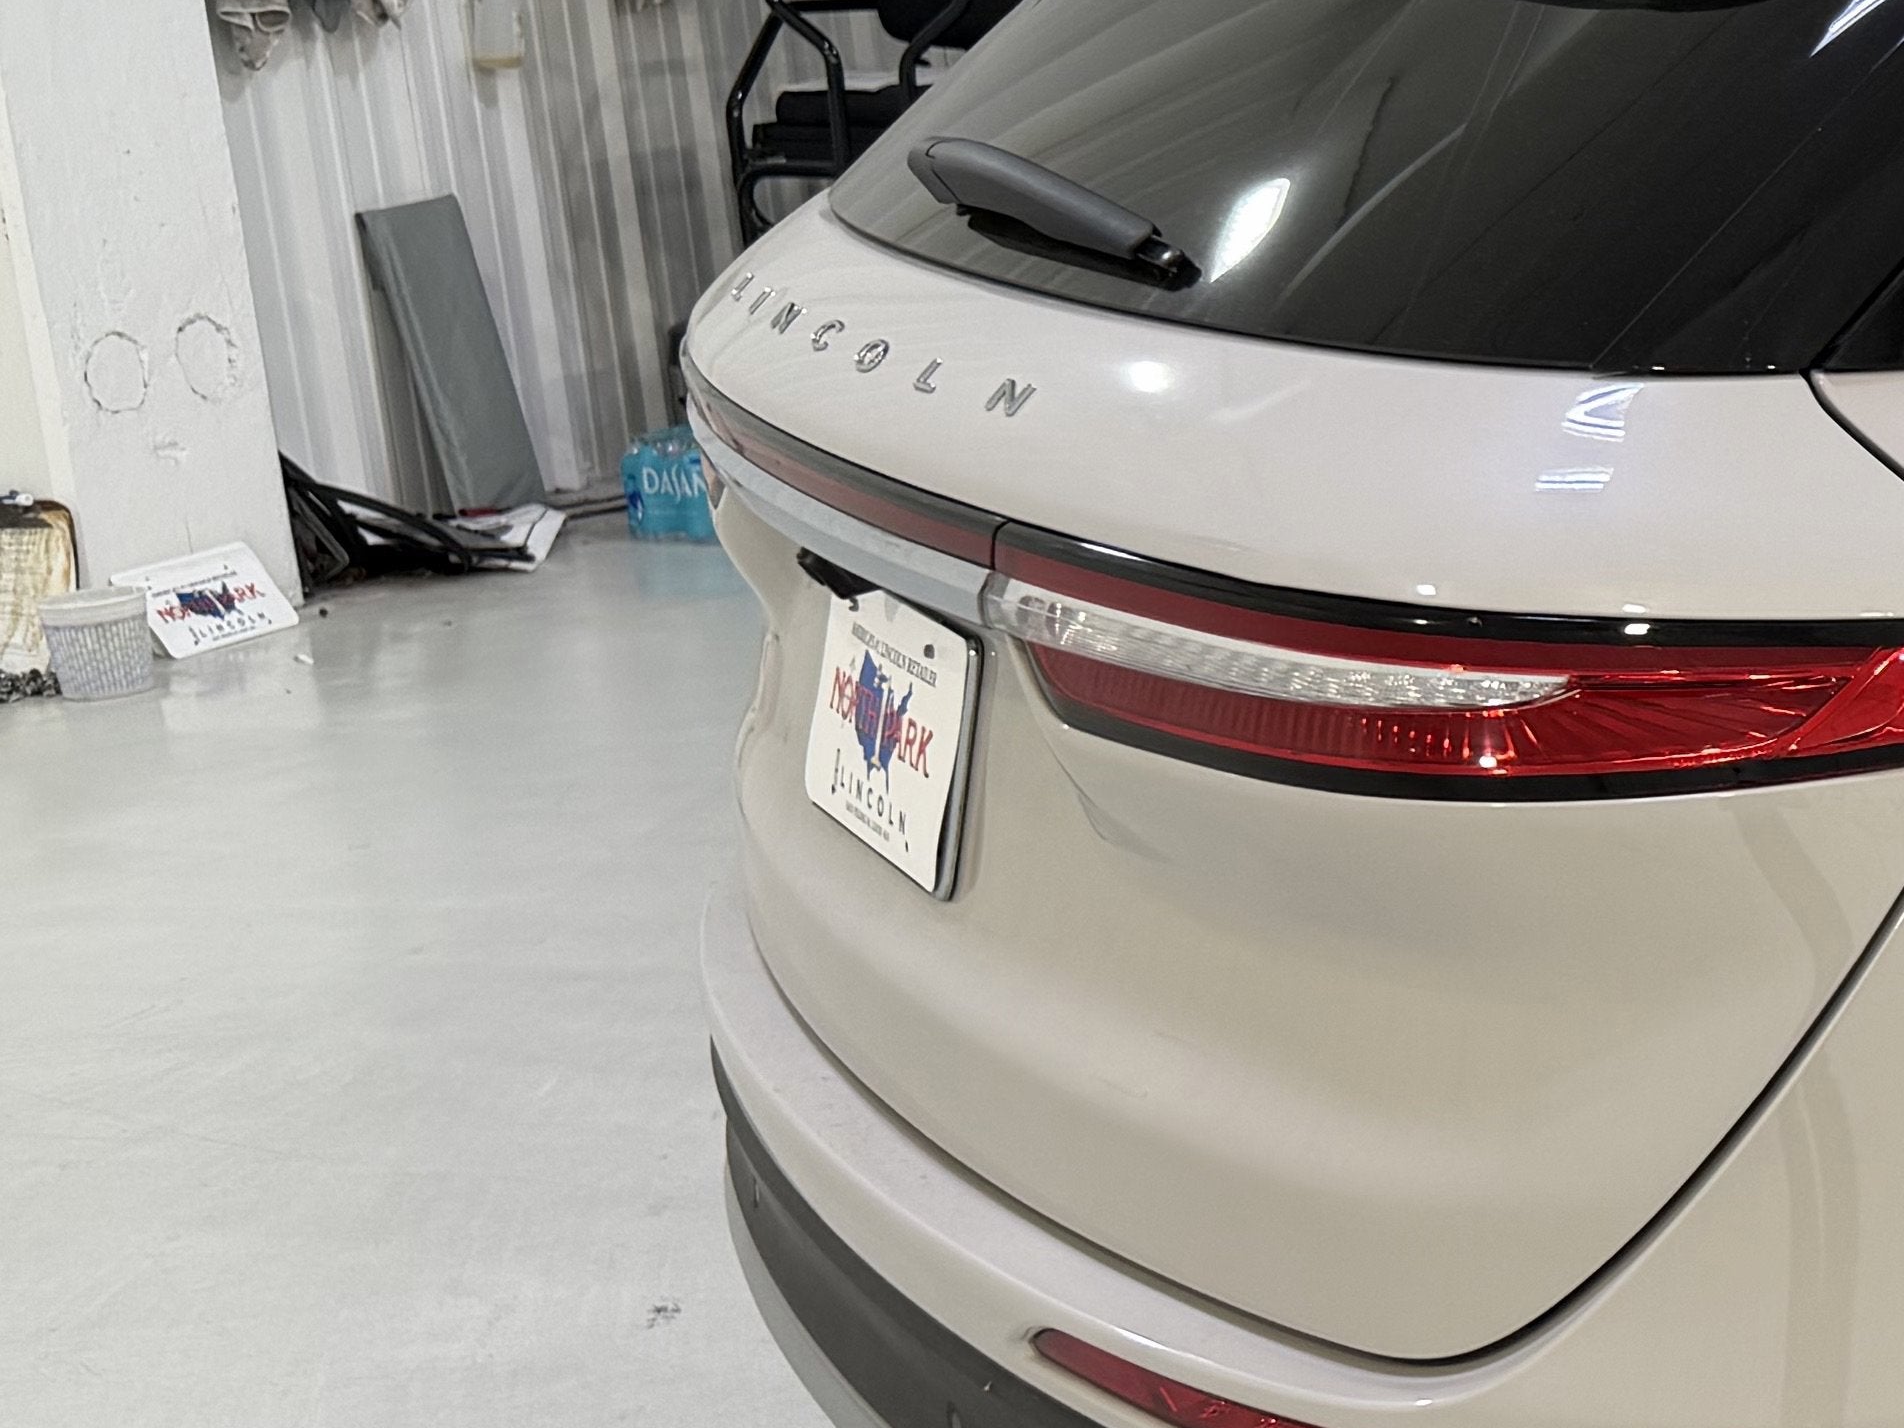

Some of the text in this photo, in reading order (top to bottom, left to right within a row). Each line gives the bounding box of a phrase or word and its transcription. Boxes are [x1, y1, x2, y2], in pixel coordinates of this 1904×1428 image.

[731, 273, 1037, 417] LINCOLN
[642, 463, 707, 504] DASAN
[830, 666, 933, 778] NORTH PARK
[840, 765, 907, 835] LINCOLN
